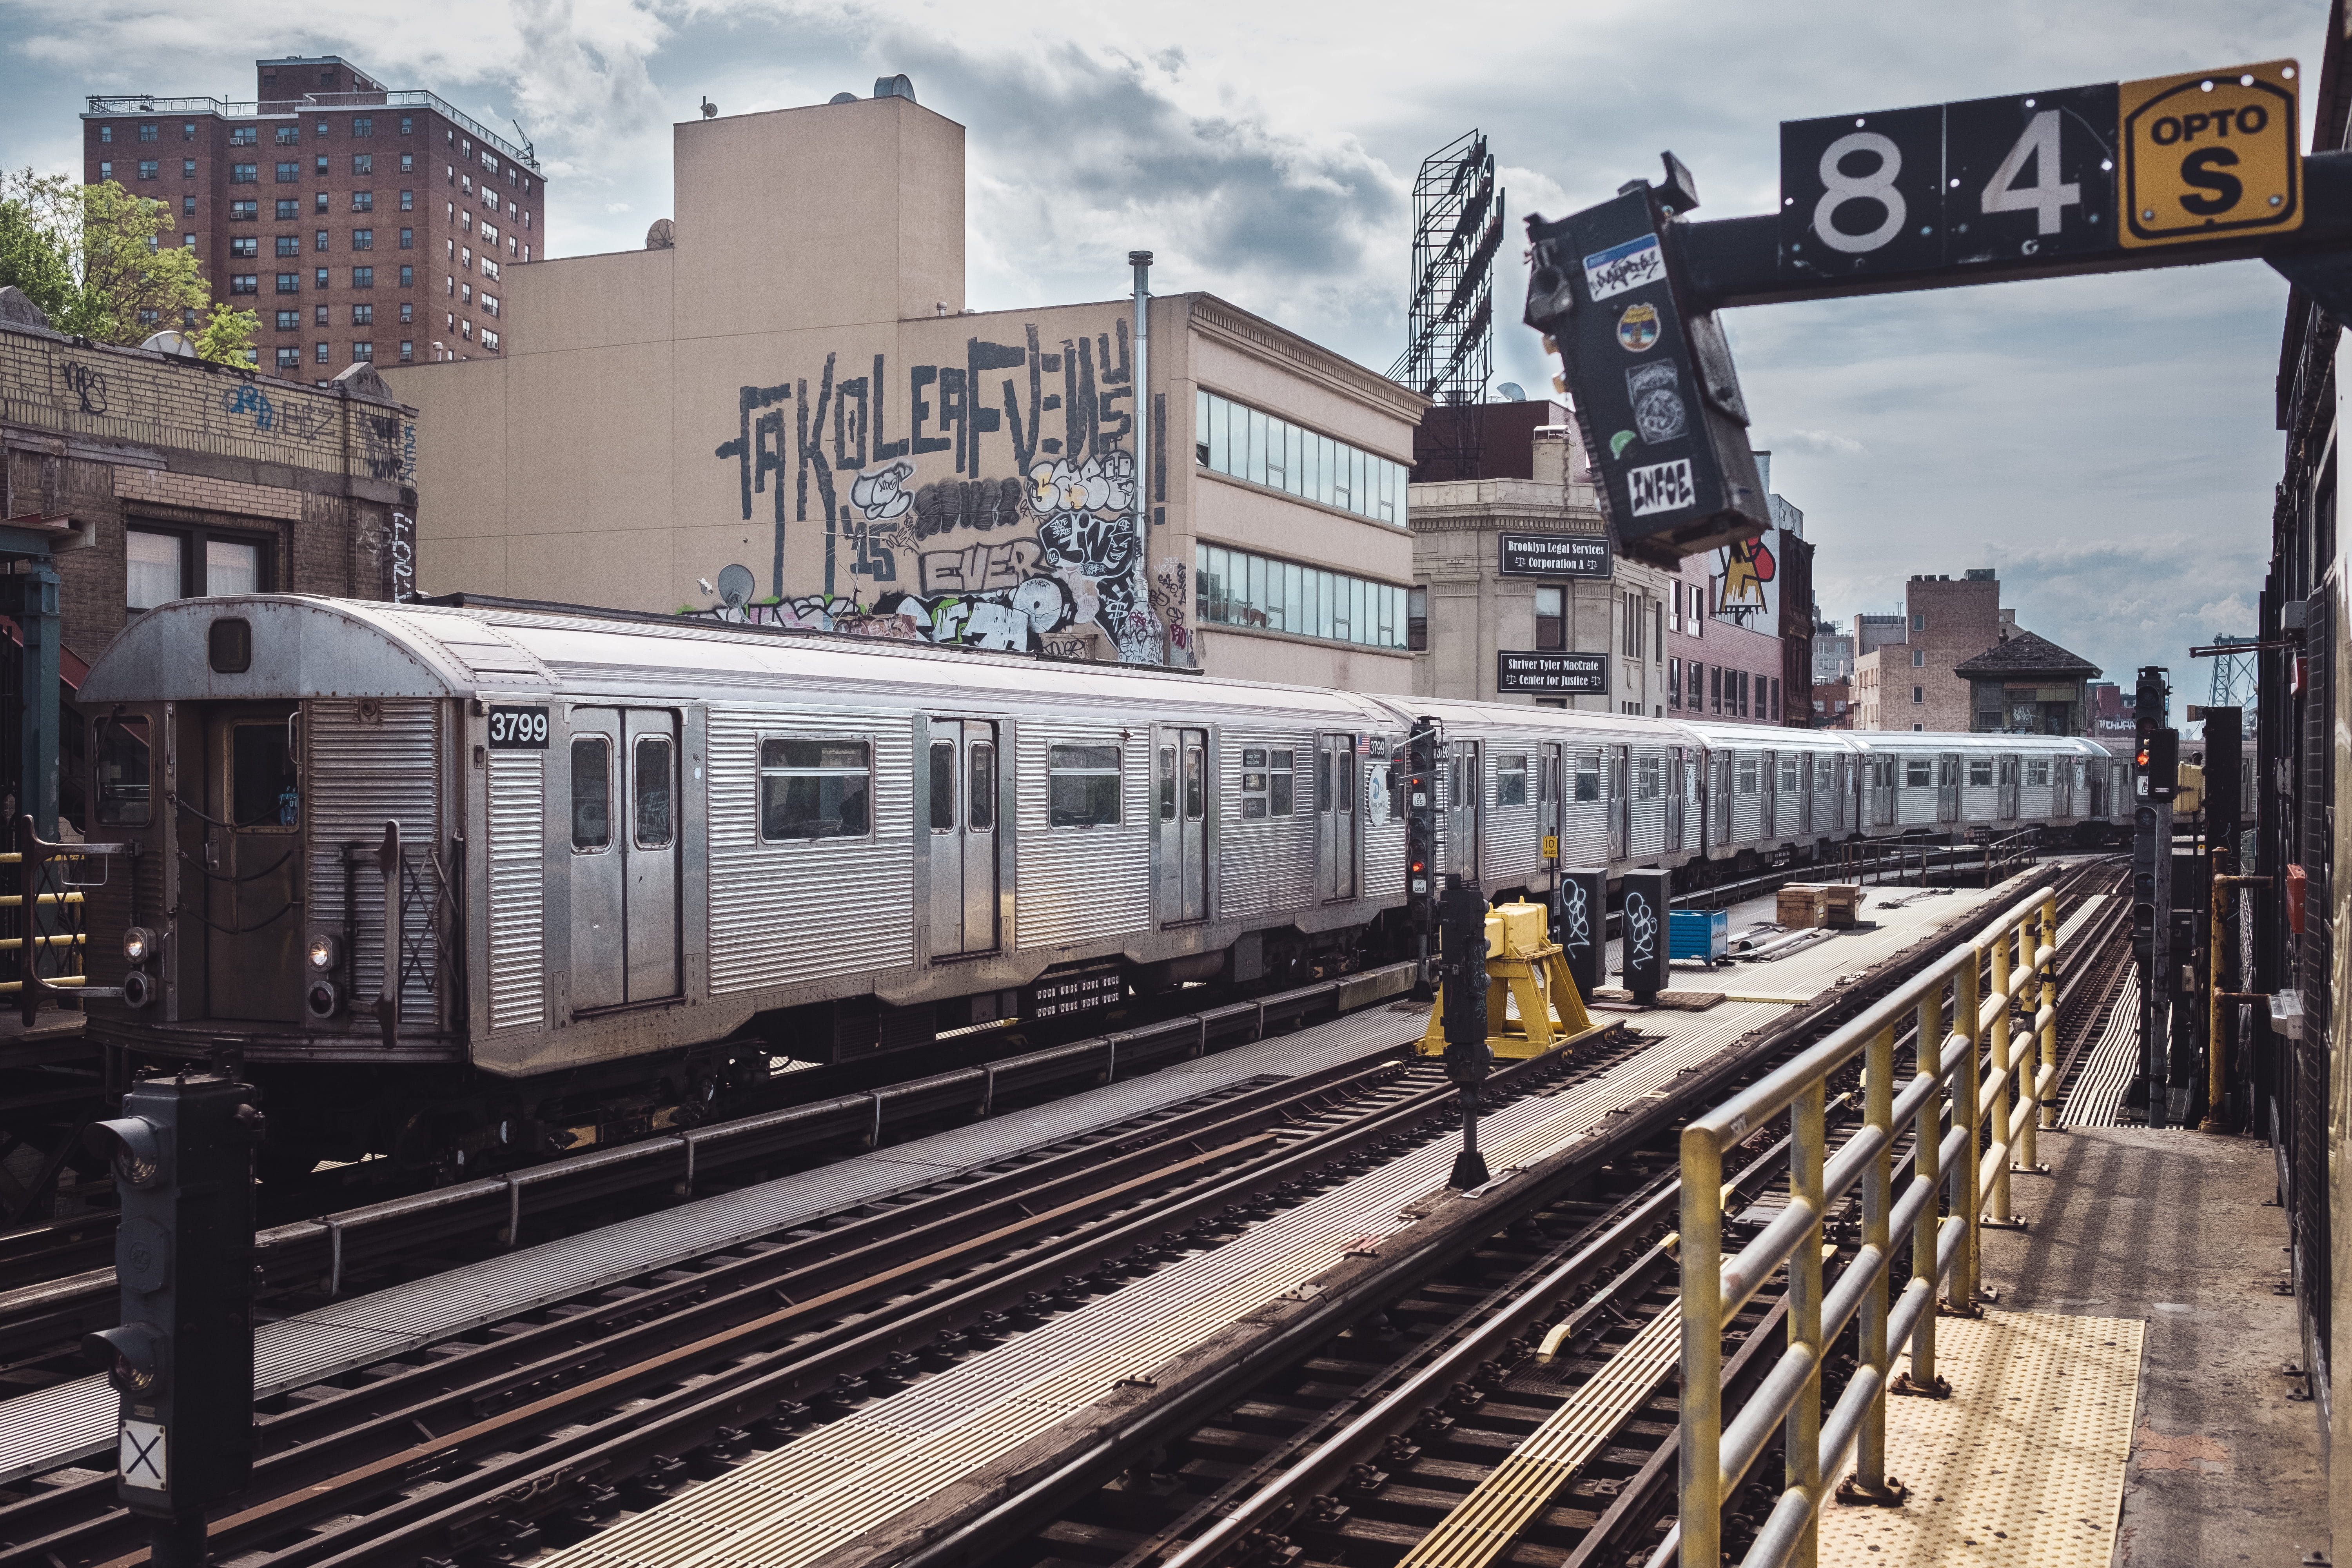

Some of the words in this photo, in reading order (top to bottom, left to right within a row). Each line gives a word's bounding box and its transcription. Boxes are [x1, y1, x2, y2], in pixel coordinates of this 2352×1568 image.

[2150, 104, 2269, 146] OPTO
[1980, 108, 2081, 236] 4
[2179, 147, 2243, 216] S
[1813, 132, 1907, 254] 8
[1508, 541, 1545, 553] Brooklyn
[1548, 543, 1569, 554] Legal
[1572, 544, 1604, 555] Services
[1528, 557, 1577, 569] Corporation
[1579, 559, 1584, 569] A
[1508, 659, 1537, 670] Shriver
[1540, 660, 1561, 671] Tyler
[1563, 660, 1599, 671] MacCrate
[1519, 675, 1544, 685] Center
[1547, 675, 1559, 685] for
[1561, 676, 1588, 686] Justice
[492, 713, 547, 742] 3799
[1370, 741, 1385, 755] 3799
[1545, 839, 1554, 848] 10
[125, 1430, 162, 1479] X
